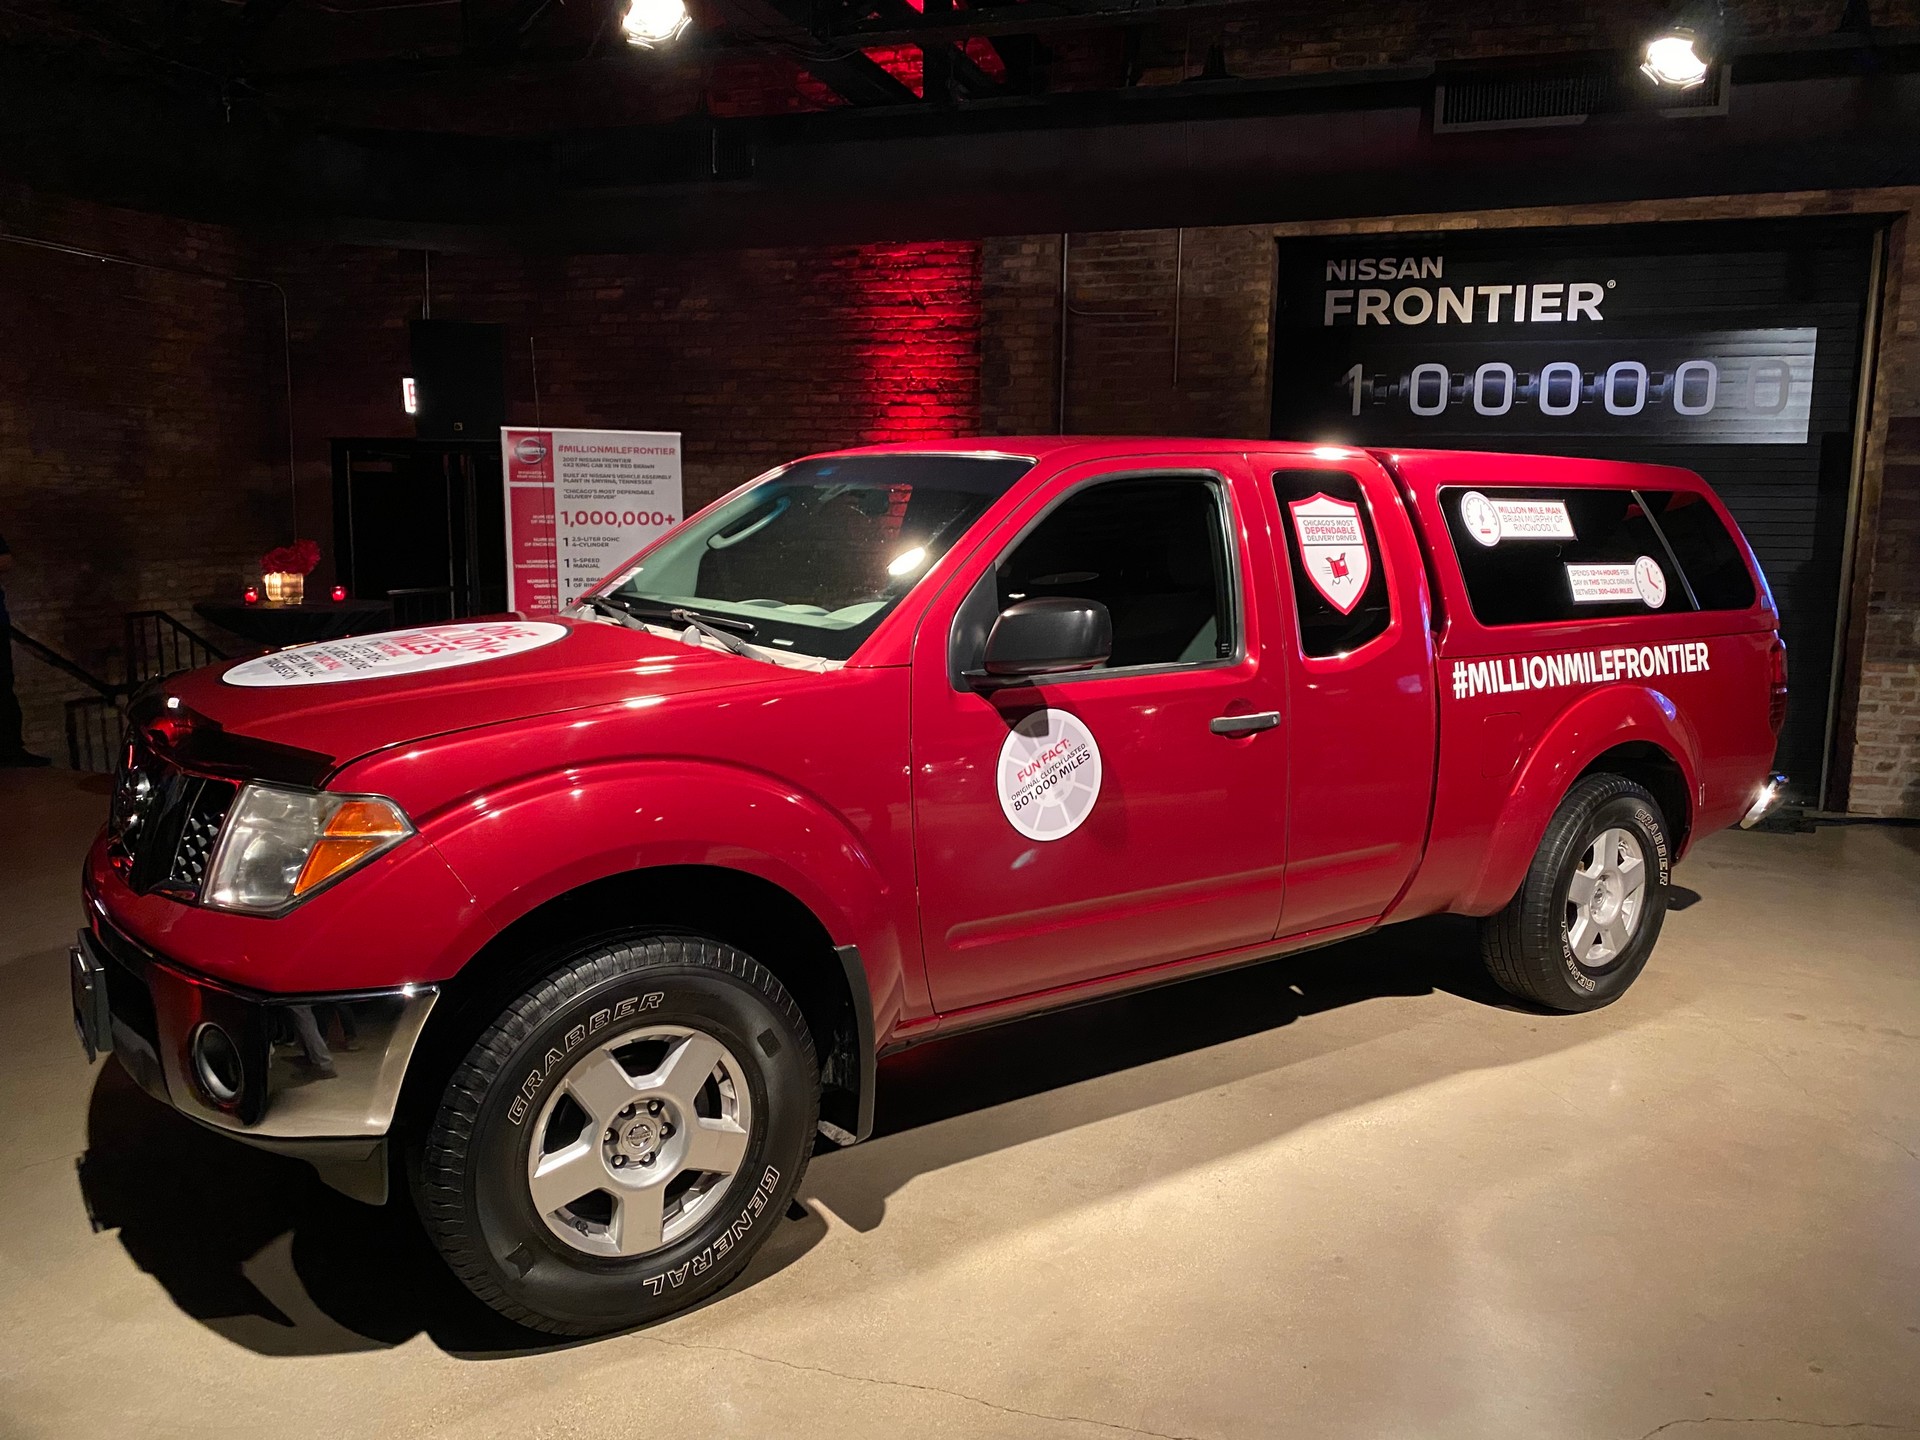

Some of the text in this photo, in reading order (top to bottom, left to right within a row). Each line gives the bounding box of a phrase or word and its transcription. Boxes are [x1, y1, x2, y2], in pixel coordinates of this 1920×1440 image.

[1325, 256, 1444, 282] NISSAN
[558, 445, 676, 455] #MILLIONMILEFRONTIER
[560, 510, 675, 528] 1,000,000+
[1525, 515, 1553, 523] MURPHY
[563, 538, 568, 546] 1
[564, 559, 569, 568] 1
[565, 578, 569, 587] 1
[1452, 642, 1710, 699] #MILLIONMILEFRONTIER
[1011, 743, 1086, 800] ORIGINAL CLUTCH LASTED
[1017, 738, 1071, 782] FUN FACT:
[1014, 750, 1091, 811] 801,000 MILES
[1634, 808, 1669, 886] GRABBER
[507, 991, 665, 1126] GRABBER
[642, 1164, 781, 1297] GENERAL
